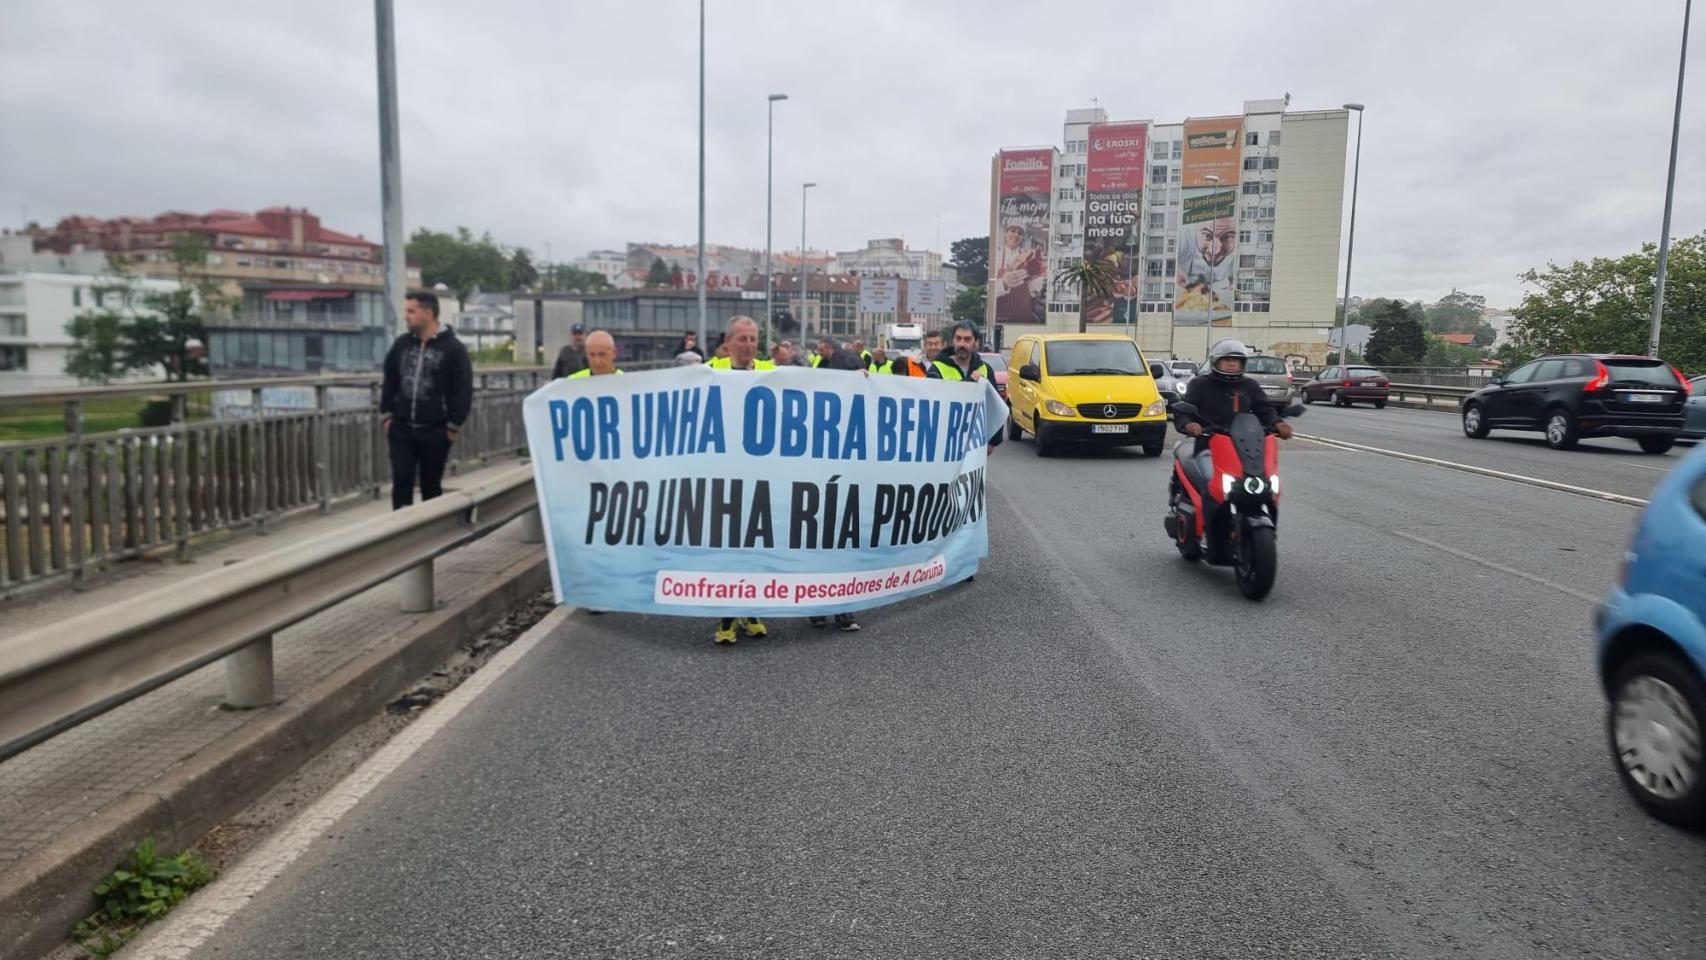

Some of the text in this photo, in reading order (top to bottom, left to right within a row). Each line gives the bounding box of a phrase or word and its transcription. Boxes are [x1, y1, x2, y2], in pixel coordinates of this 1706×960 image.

[1106, 138, 1139, 148] EROSKI
[1005, 157, 1043, 169] Familia
[1089, 200, 1138, 212] Galicia
[1088, 215, 1106, 225] na
[1088, 227, 1124, 237] mesa
[549, 396, 621, 461] POR
[631, 385, 726, 459] UNHA
[743, 386, 867, 460] OBRA
[877, 396, 940, 462] BEN
[585, 481, 650, 546] POR
[655, 477, 774, 548] UNHA
[789, 474, 860, 549] RÍA
[661, 561, 944, 603] Confraría de pescadores de A Coruña
